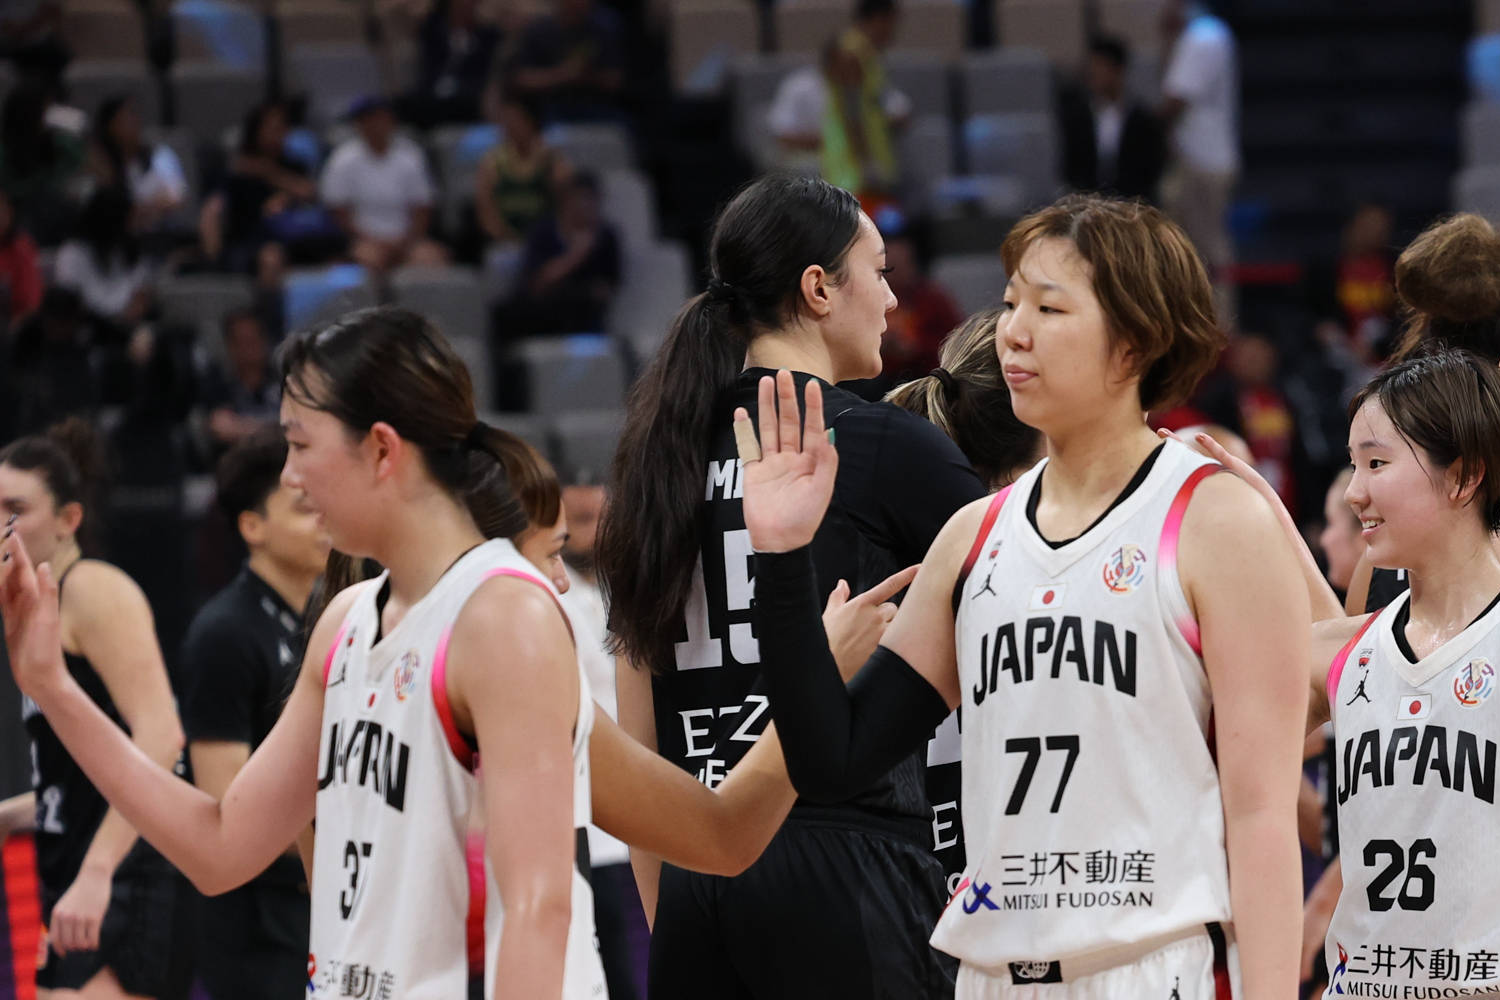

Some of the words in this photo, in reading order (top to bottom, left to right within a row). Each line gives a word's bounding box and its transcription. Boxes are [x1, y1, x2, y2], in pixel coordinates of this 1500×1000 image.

[973, 616, 1137, 706] JAPAN
[1005, 735, 1080, 815] 77
[1338, 725, 1497, 806] JAPAN
[1001, 850, 1155, 886] 三井不動産
[1363, 838, 1437, 911] 26
[1004, 893, 1048, 911] MITSUI
[1056, 890, 1153, 909] FUDOSAN
[1347, 981, 1397, 1000] MITSUI
[1348, 944, 1499, 982] 三井不動産
